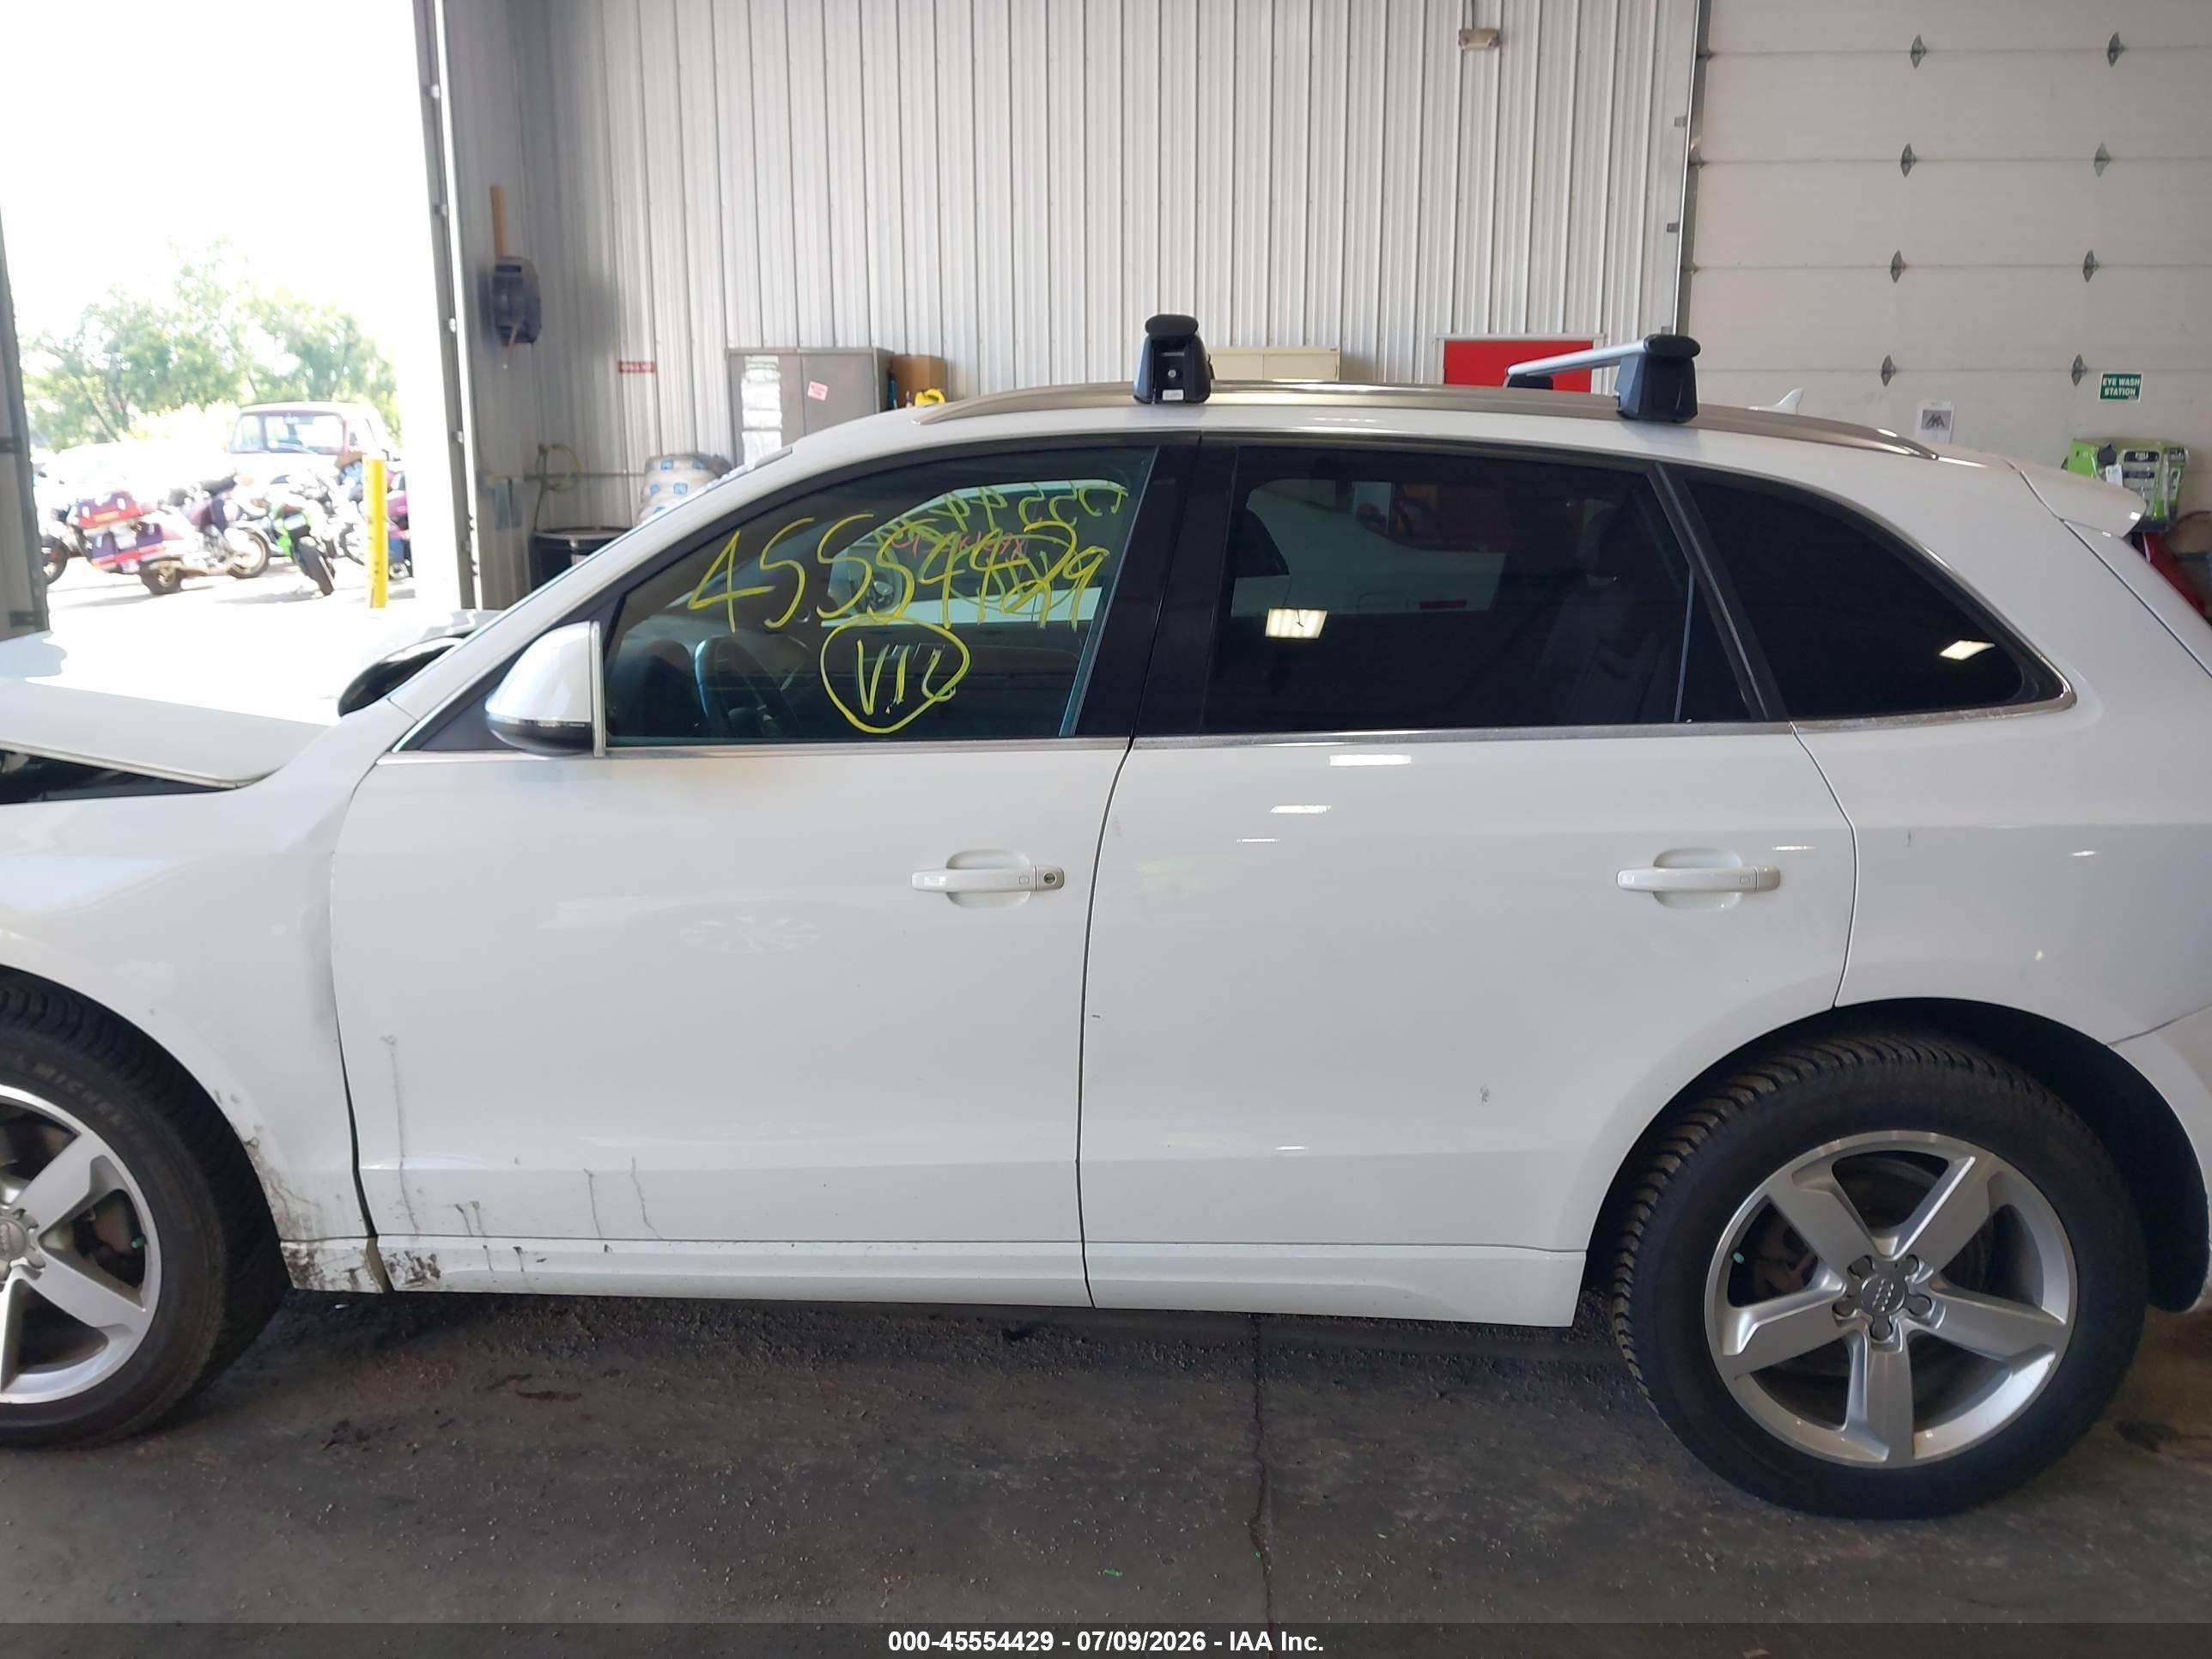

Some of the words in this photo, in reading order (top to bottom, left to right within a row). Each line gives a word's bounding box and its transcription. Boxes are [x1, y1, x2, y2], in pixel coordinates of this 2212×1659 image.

[2103, 377, 2117, 386] EYE
[2119, 377, 2141, 387] WASH
[2105, 387, 2136, 396] STATION
[687, 513, 1110, 633] 45554429
